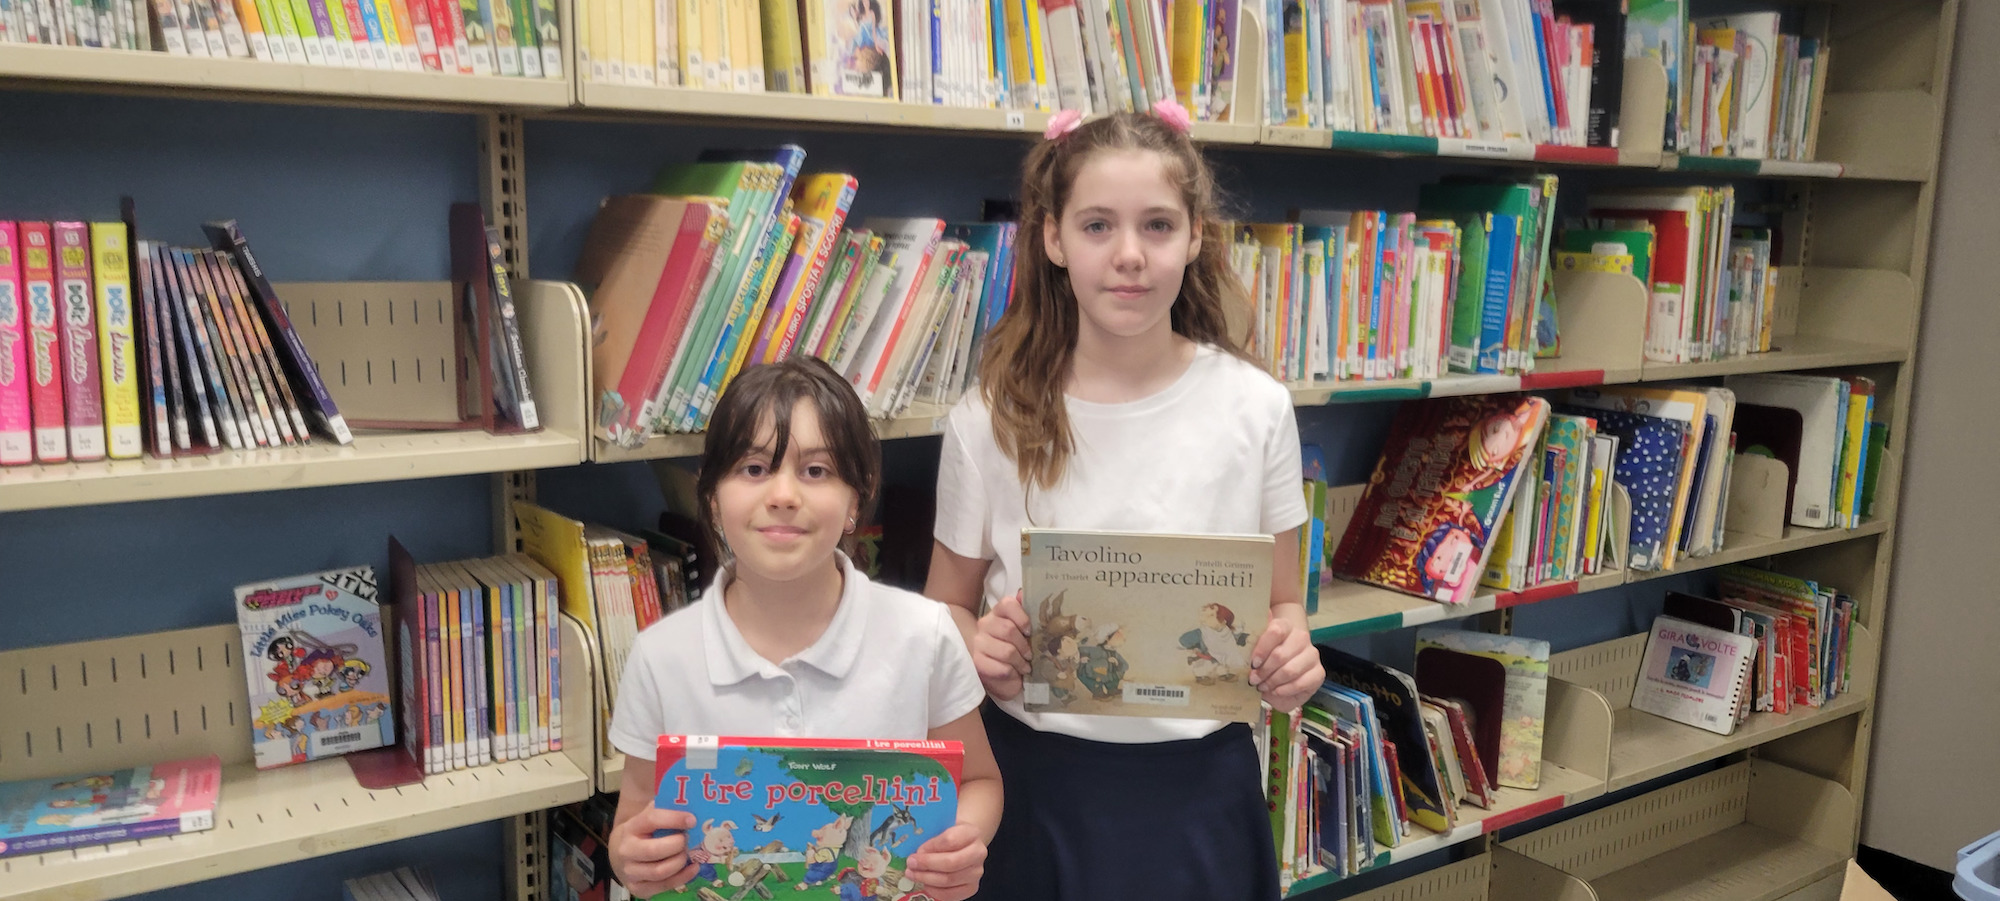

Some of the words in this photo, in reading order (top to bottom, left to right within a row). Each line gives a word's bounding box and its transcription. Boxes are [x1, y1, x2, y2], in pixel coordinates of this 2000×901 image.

[818, 214, 843, 257] SCOPRI
[814, 257, 825, 267] E
[795, 267, 821, 312] SPOSTA
[785, 312, 802, 338] LIBRO
[1046, 545, 1142, 565] Tavolino
[1195, 560, 1223, 568] Fratelli
[1224, 560, 1254, 570] Grimm
[1095, 568, 1254, 588] apparecchiati!
[250, 628, 276, 658] Little
[274, 608, 306, 630] Miss
[309, 604, 350, 622] Pokey
[352, 613, 378, 638] Oaks
[1658, 629, 1685, 644] GIRA
[1700, 640, 1738, 656] VOLTE
[874, 740, 890, 748] tre
[892, 740, 946, 750] porcellini
[788, 762, 810, 770] TONY
[812, 762, 838, 771] WOLF
[675, 776, 690, 805] I
[702, 772, 754, 804] tre
[765, 774, 942, 809] porcellini
